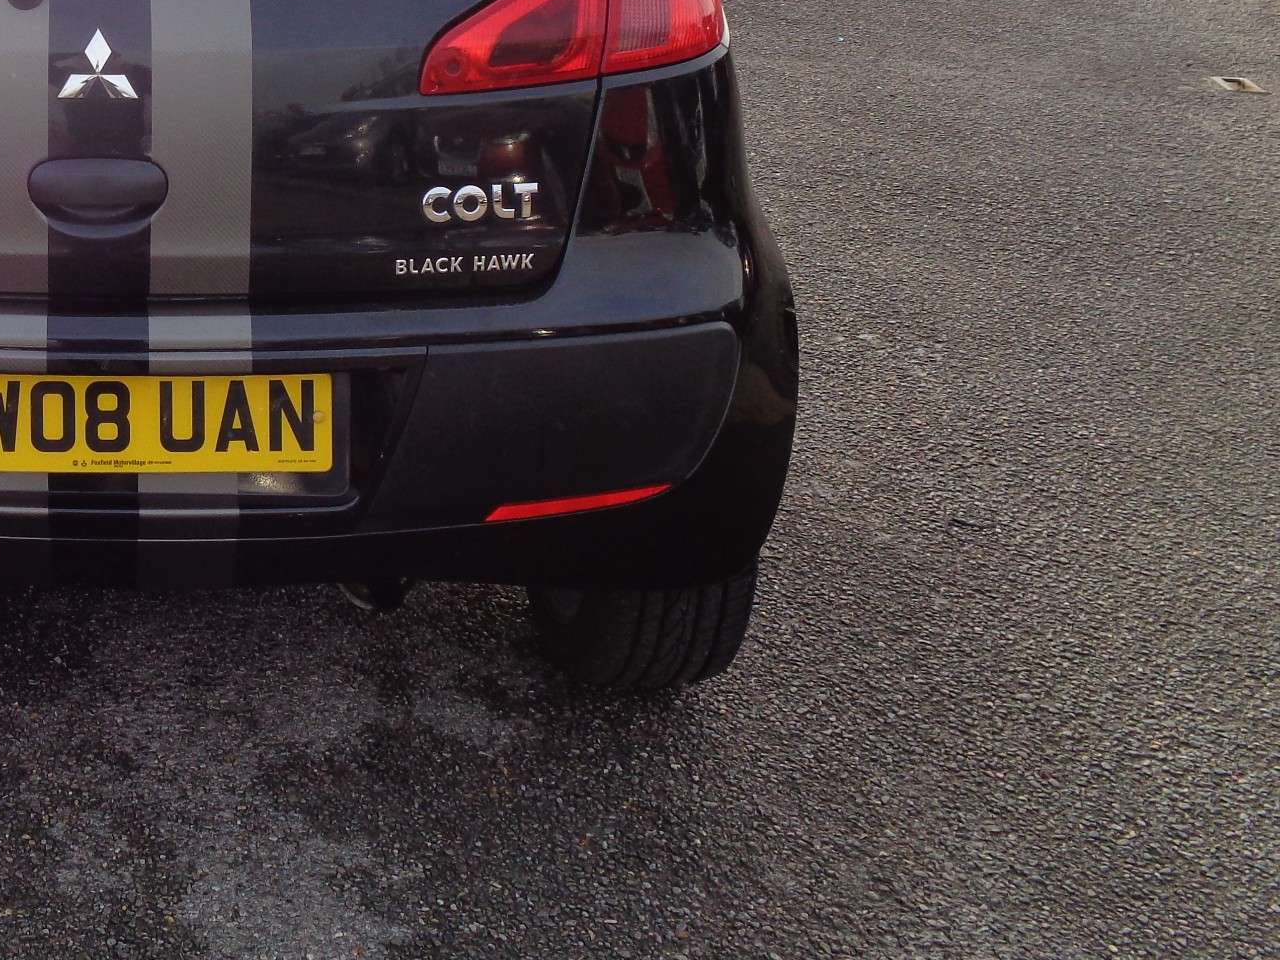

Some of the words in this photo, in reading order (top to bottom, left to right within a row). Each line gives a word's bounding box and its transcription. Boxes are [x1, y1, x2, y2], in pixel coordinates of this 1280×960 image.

[422, 182, 539, 223] COLT
[395, 256, 464, 276] BLACK
[473, 253, 535, 272] HAWK
[159, 380, 315, 453] UAN
